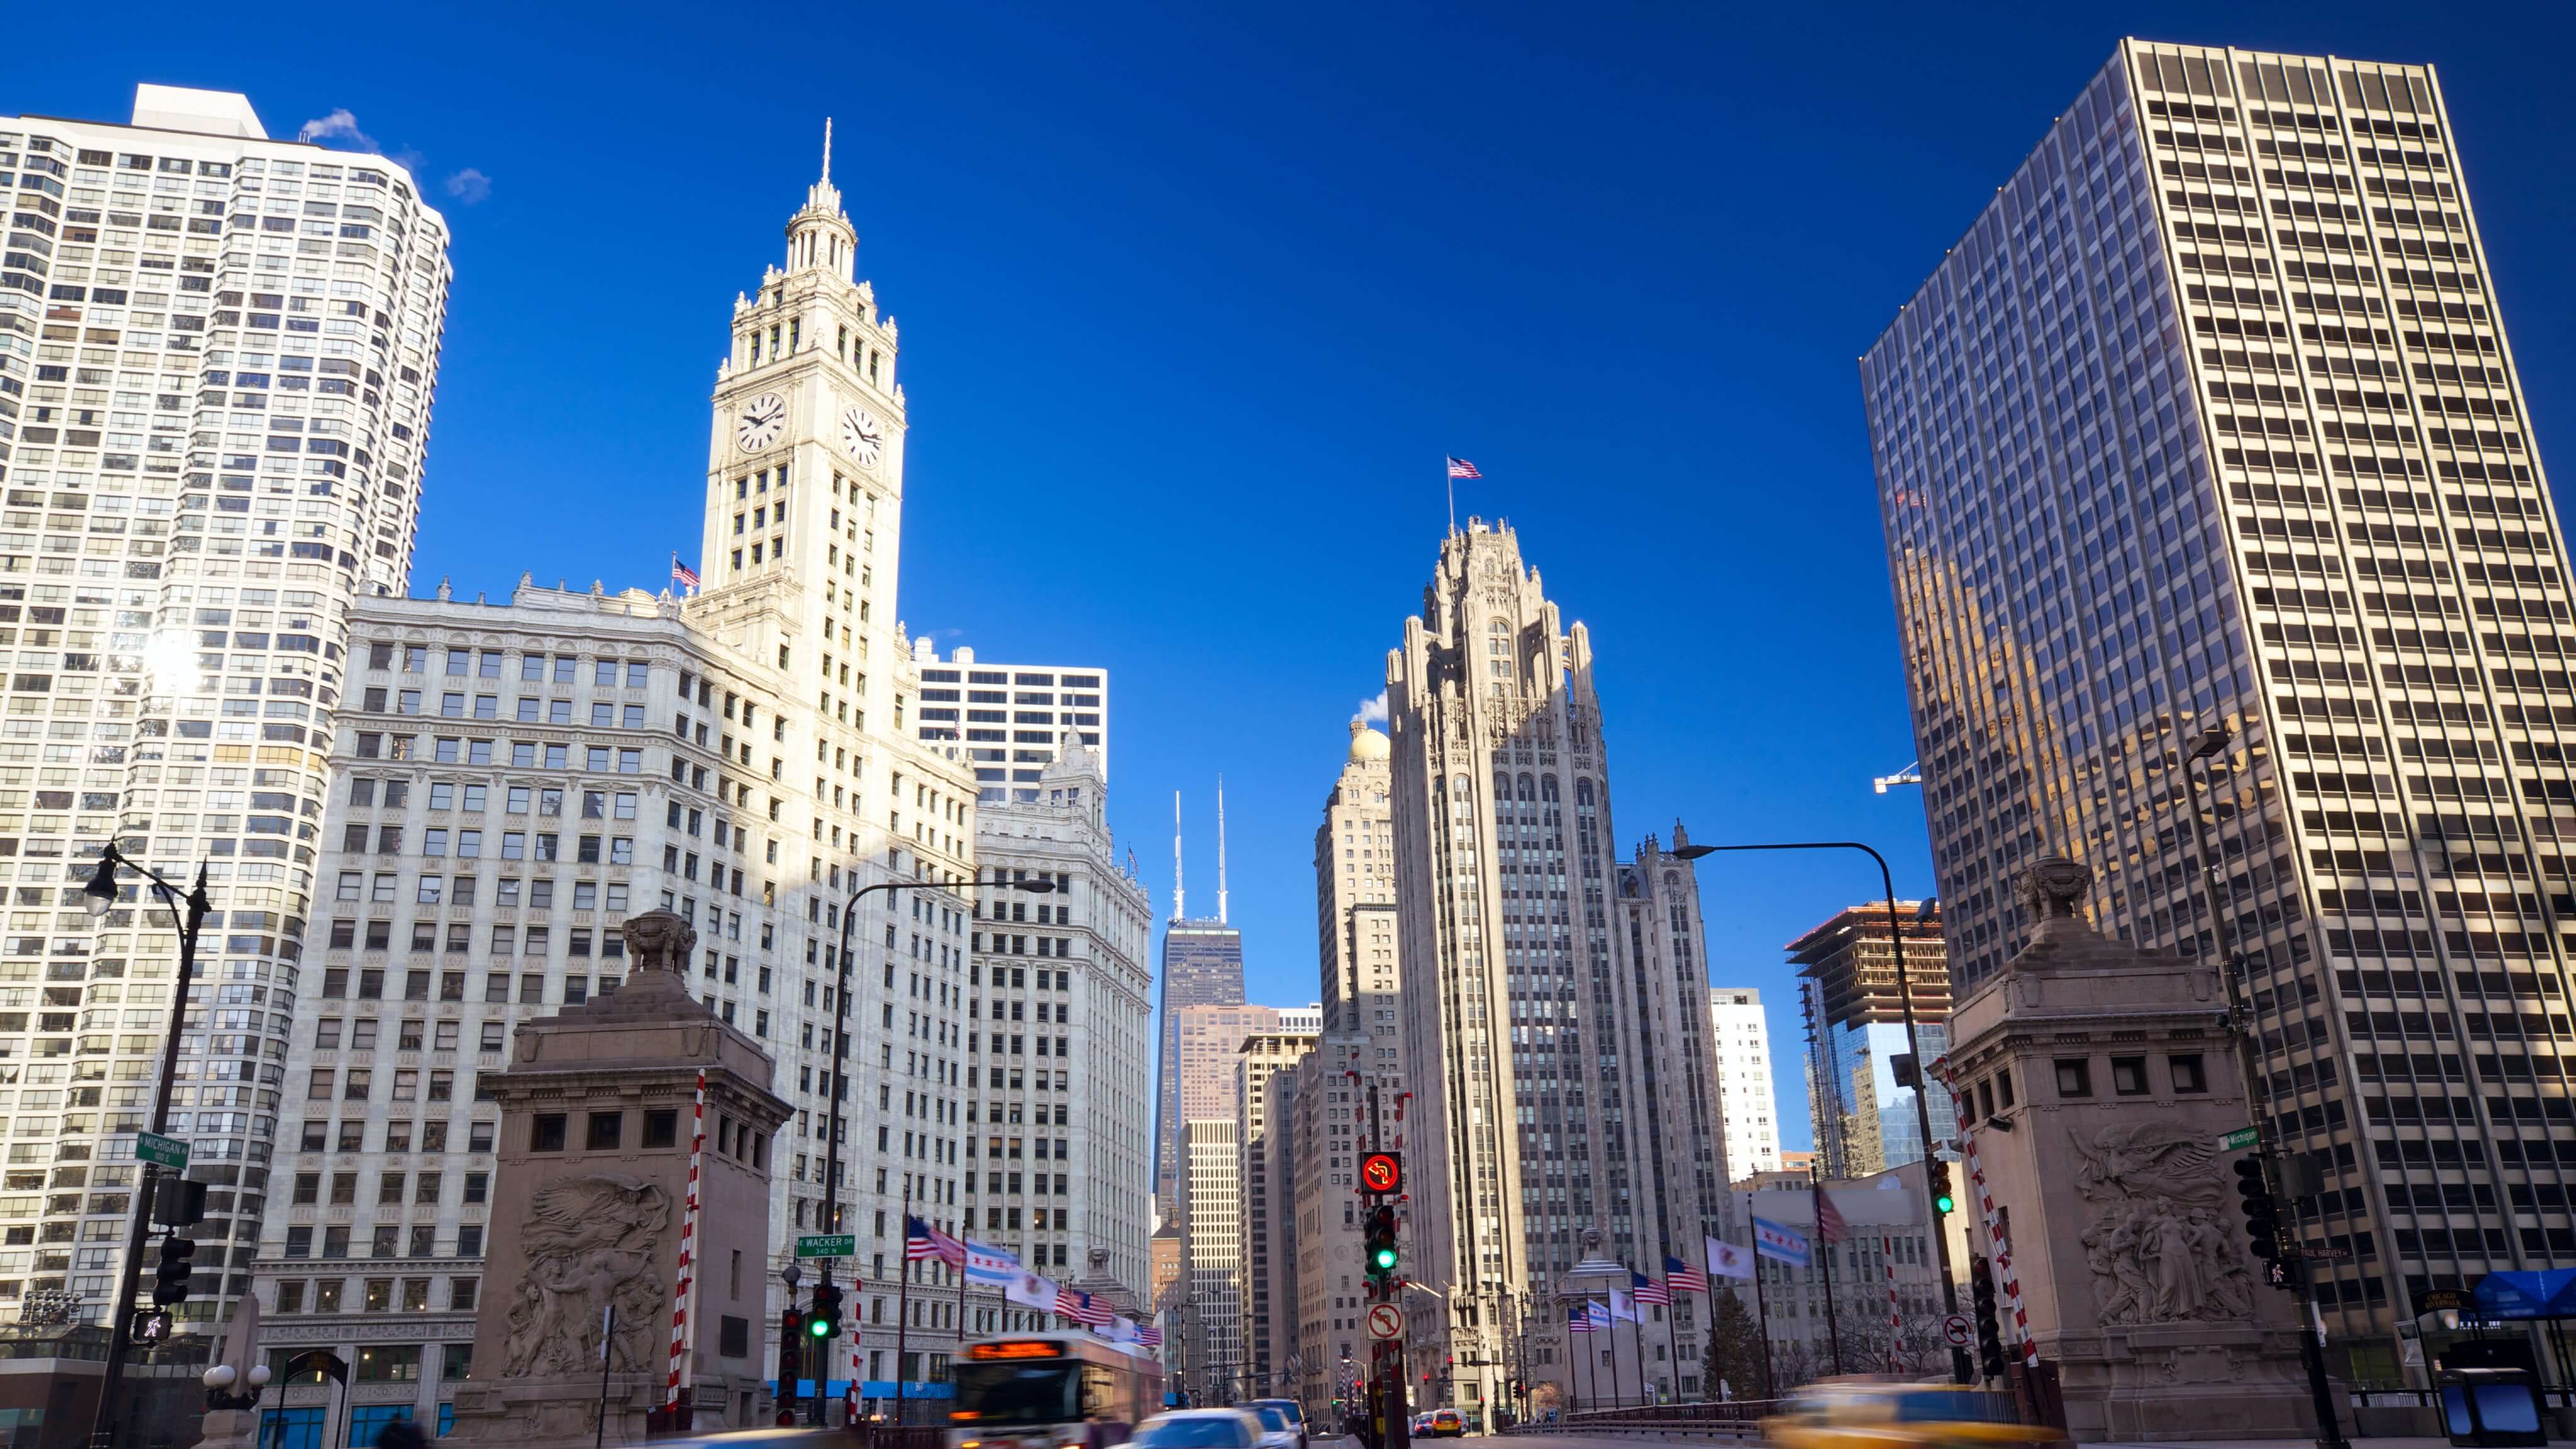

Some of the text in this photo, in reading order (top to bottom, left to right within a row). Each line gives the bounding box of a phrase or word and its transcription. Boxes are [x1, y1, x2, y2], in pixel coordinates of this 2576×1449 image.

[2230, 1131, 2255, 1144] Michigan
[145, 1136, 180, 1154] MICHIGAN
[806, 1238, 841, 1247] WACKER
[2301, 1248, 2317, 1257] PAUL
[2318, 1249, 2342, 1257] HARVEY
[2425, 1299, 2461, 1308] RIVERWALK
